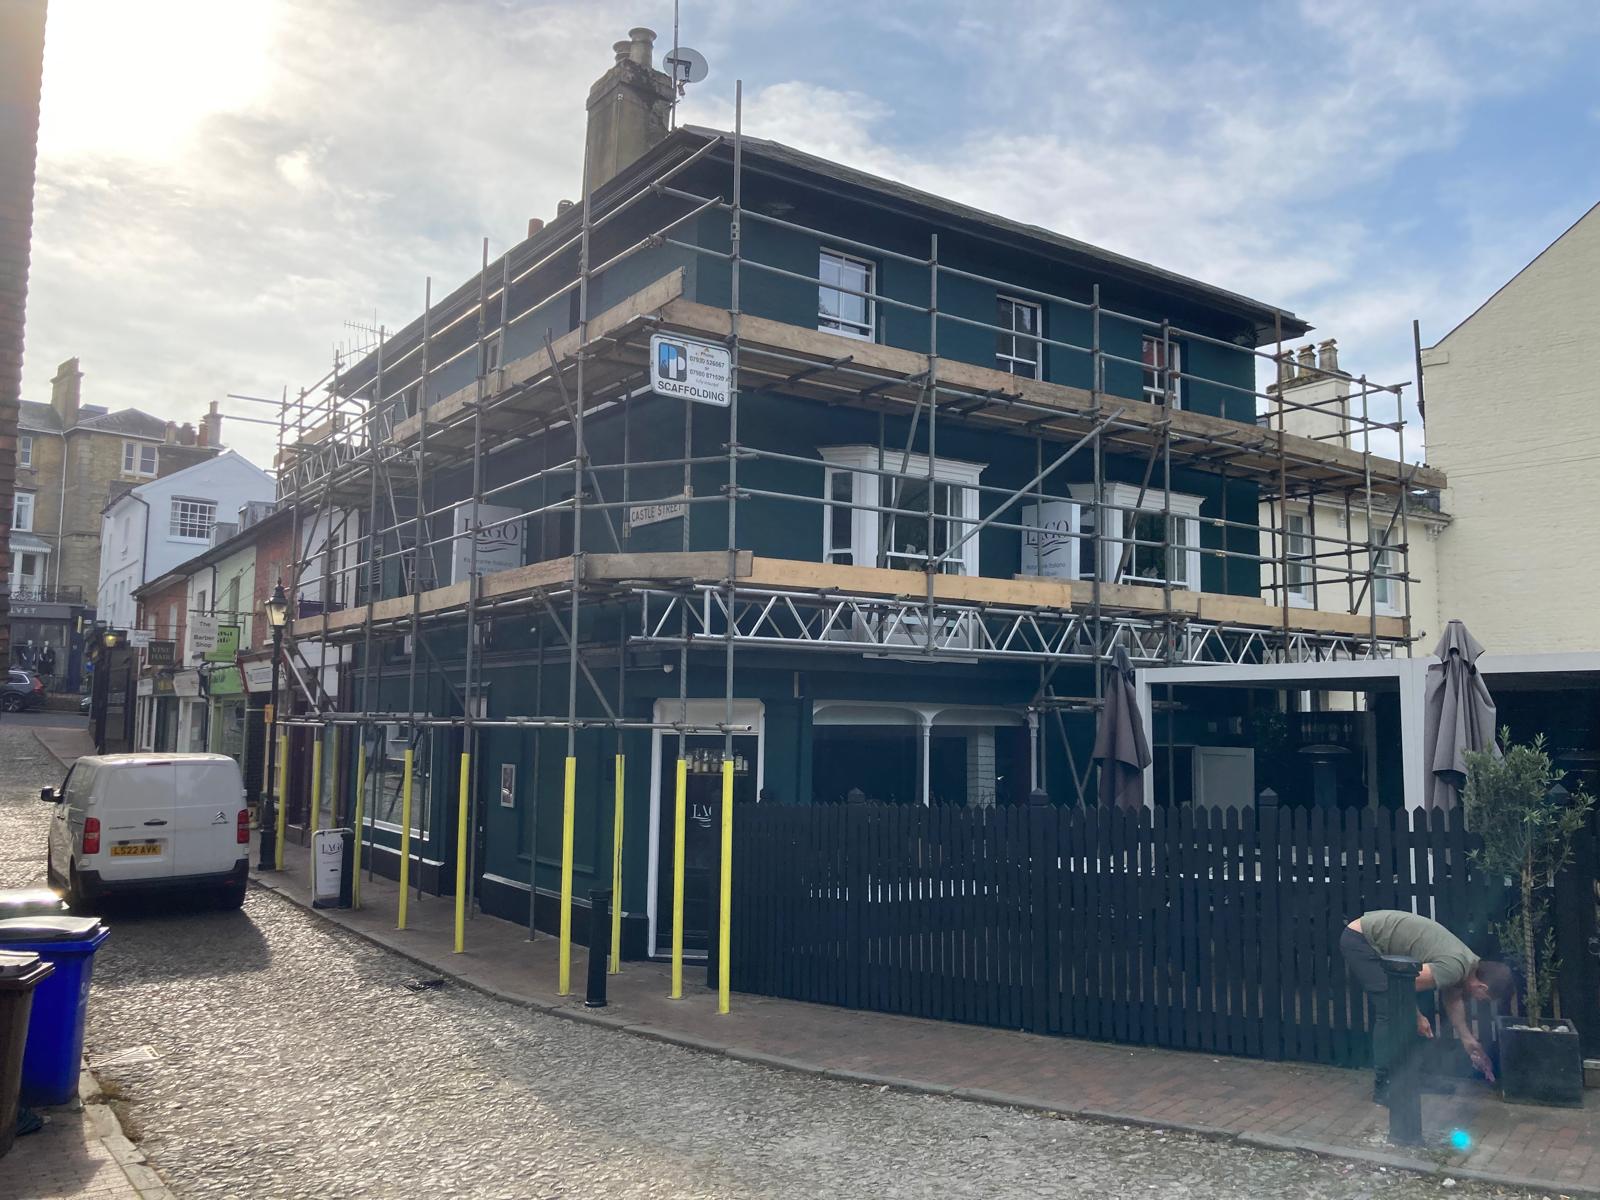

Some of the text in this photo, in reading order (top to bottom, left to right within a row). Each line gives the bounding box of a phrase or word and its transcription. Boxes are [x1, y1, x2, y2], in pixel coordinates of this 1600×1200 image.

[657, 380, 725, 402] SCAFFOLDING
[631, 503, 681, 522] CASTLE STREET
[1026, 519, 1070, 546] LGO
